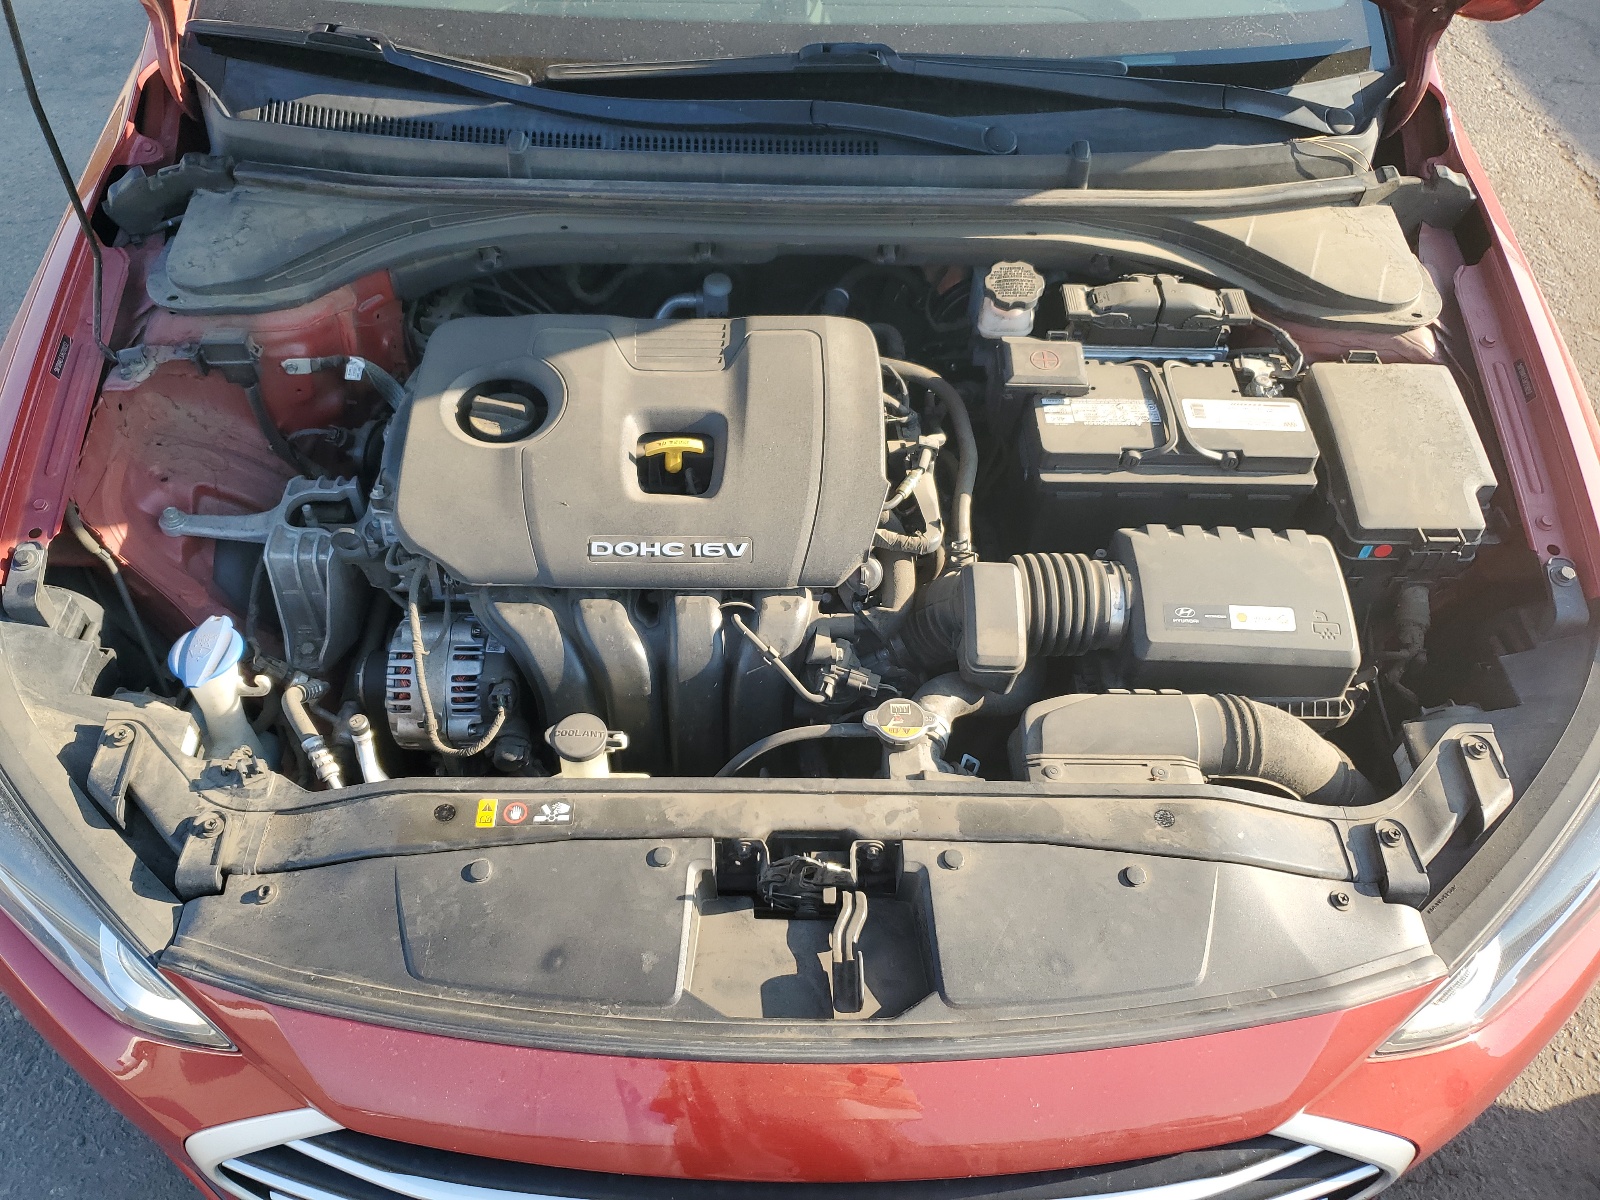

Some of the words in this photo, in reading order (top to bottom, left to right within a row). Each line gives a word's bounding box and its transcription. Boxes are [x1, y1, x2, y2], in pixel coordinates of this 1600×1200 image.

[589, 541, 685, 558] DOHC
[692, 541, 749, 558] 16V
[554, 729, 605, 738] COOLANT
